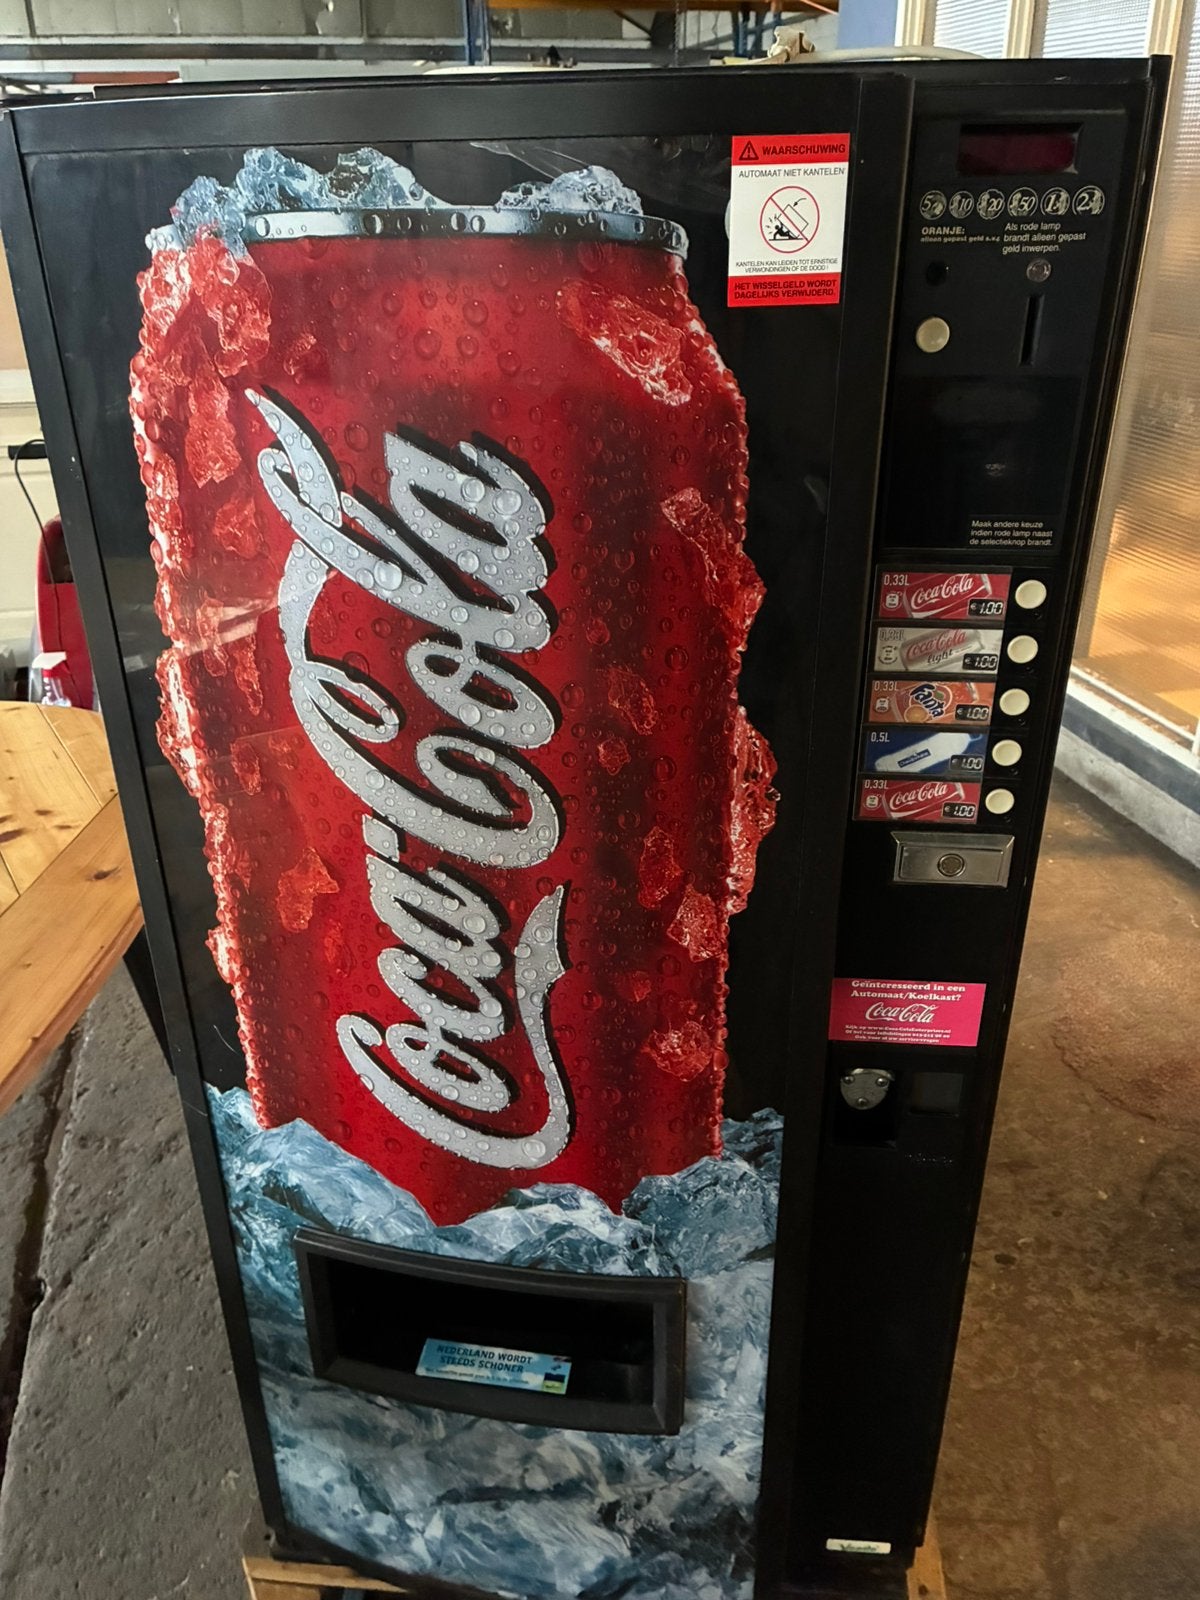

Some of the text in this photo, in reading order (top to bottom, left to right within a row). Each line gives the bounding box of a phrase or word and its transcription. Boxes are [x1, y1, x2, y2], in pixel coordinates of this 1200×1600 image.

[762, 144, 846, 156] WAARSCHUWING
[738, 167, 845, 178] AUTOMAAT NIET KANTELEN
[959, 197, 973, 211] 10
[987, 198, 1004, 212] 20
[1020, 197, 1036, 211] 50
[921, 226, 965, 235] ORANJE:
[1005, 222, 1061, 233] Als rode lamp
[1004, 232, 1086, 242] brandt alleen gepast
[1002, 245, 1060, 255] geld inwerpen.
[734, 280, 837, 291] HET WISSELGELD WORDT
[734, 290, 779, 299] DAGELIJKS
[972, 520, 1044, 529] Maak andere keuze
[971, 529, 993, 537] indien
[1012, 529, 1031, 539] lamp
[1032, 530, 1053, 538] naast
[980, 538, 1026, 548] selectieknop
[884, 574, 909, 586] 0.33L
[911, 574, 974, 610] Coca-Cola
[979, 602, 1004, 615] 1.00
[906, 629, 967, 661] Coca-Cola
[927, 649, 954, 664] light
[974, 656, 998, 668] 1.00
[874, 681, 899, 692] 0.33L
[910, 682, 945, 720] Fanta
[967, 707, 989, 720] 1.00
[871, 732, 890, 743] 0.5L
[962, 757, 982, 770] 1.00
[247, 387, 573, 1170] Coca-Cola
[865, 780, 889, 790] 0.33L
[889, 782, 950, 811] Coca-Cola
[954, 805, 976, 818] 1.00
[851, 980, 931, 991] Geïnteresseerd
[933, 983, 944, 991] in
[850, 990, 962, 1002] Automaat/Koelkast?
[865, 1001, 939, 1024] Coca-Cola
[437, 1344, 533, 1364] NEDERLAND WORDT
[440, 1355, 524, 1373] STEEDS SCHONER
